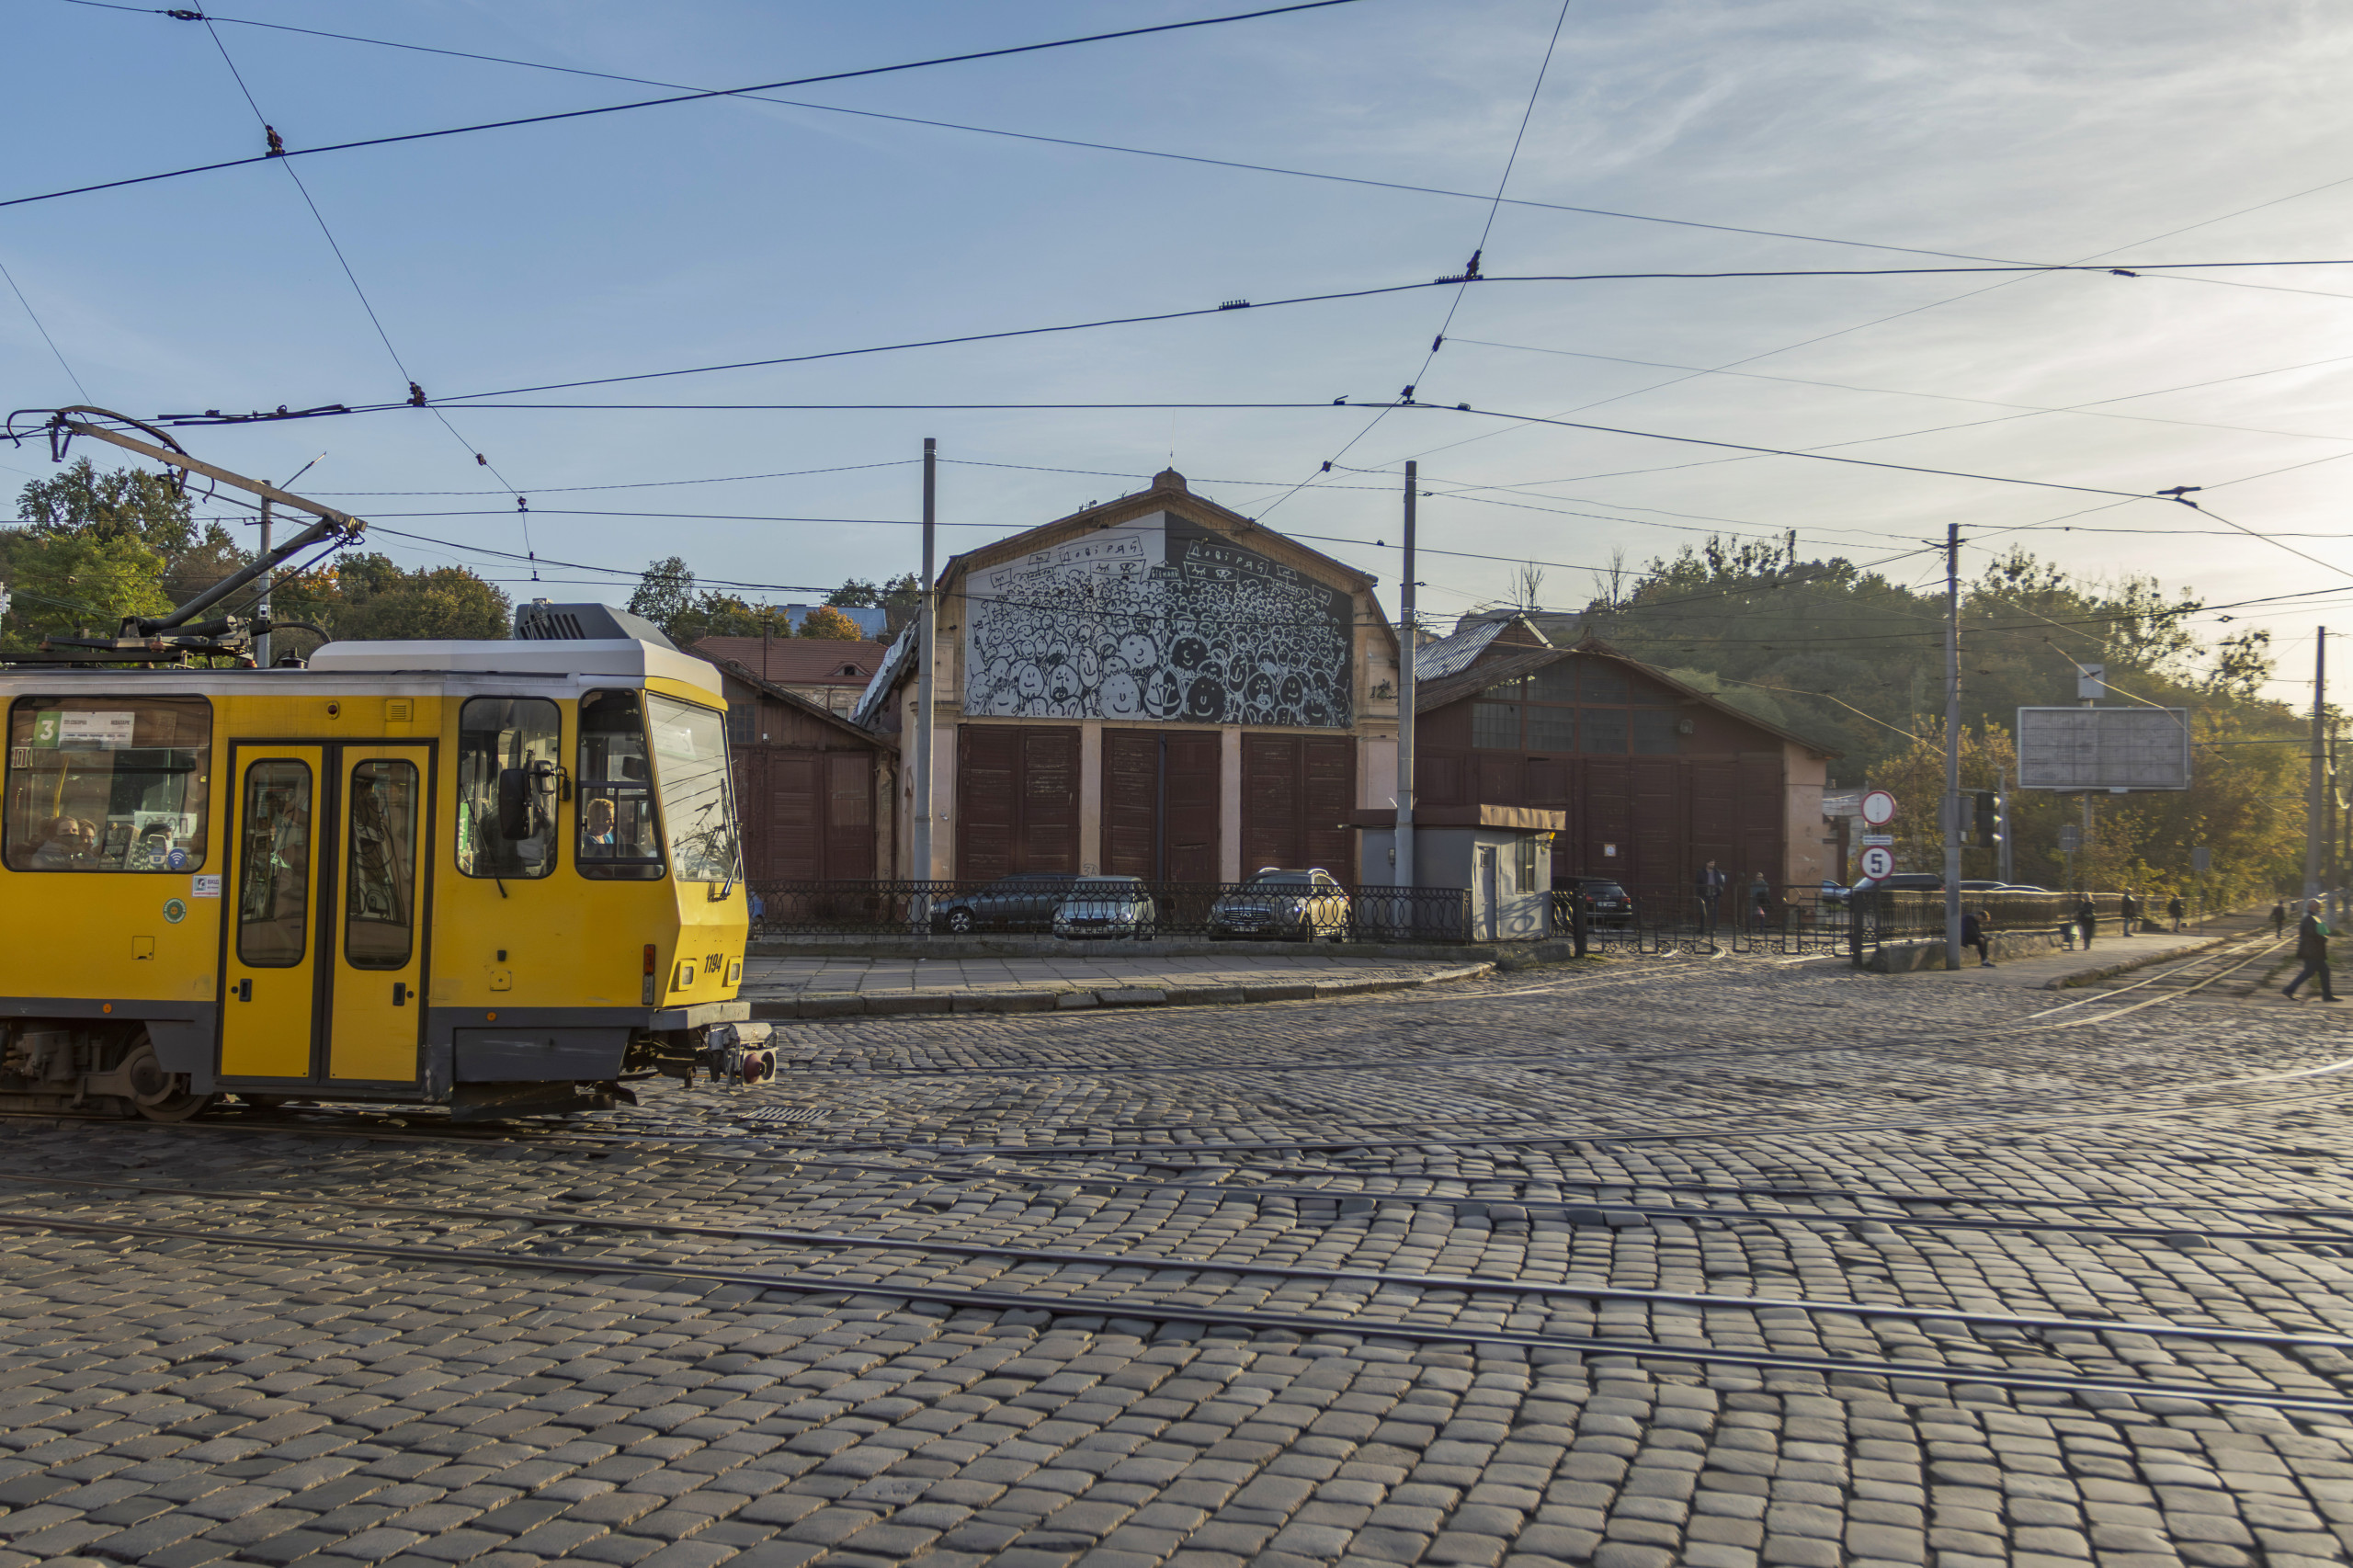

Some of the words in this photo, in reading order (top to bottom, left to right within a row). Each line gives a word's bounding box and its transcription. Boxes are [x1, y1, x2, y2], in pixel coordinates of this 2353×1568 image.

[40, 720, 55, 741] 3
[1871, 854, 1882, 874] 5
[703, 952, 724, 974] 1194
